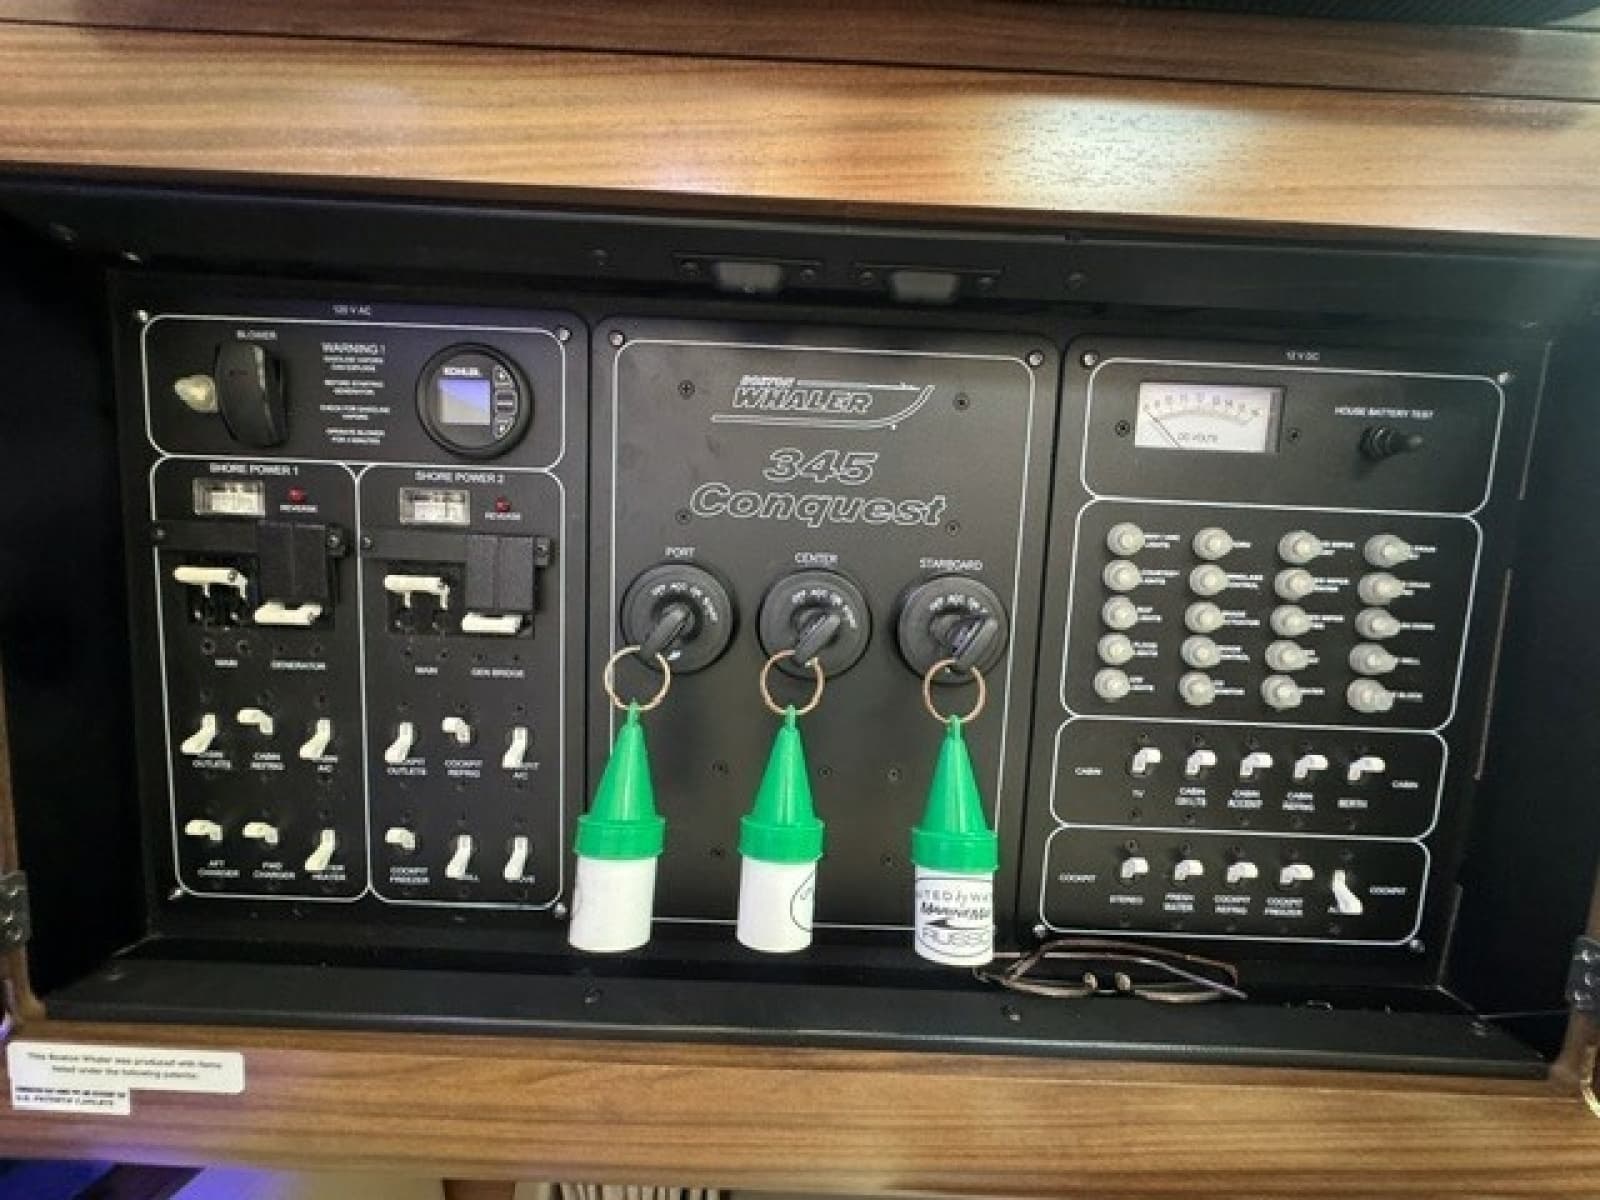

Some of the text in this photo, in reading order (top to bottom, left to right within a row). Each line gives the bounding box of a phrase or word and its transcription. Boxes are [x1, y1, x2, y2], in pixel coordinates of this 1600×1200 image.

[321, 342, 378, 355] WARNING
[731, 386, 873, 414] WHALER
[209, 463, 247, 474] SHORE
[250, 464, 291, 476] POWER
[762, 446, 880, 486] 345
[414, 470, 453, 482] SHORE
[455, 472, 497, 484] POWER
[689, 481, 949, 529] Conquest
[664, 546, 696, 559] PORT
[794, 552, 839, 565] CENTER
[919, 557, 984, 571] STARBOARD
